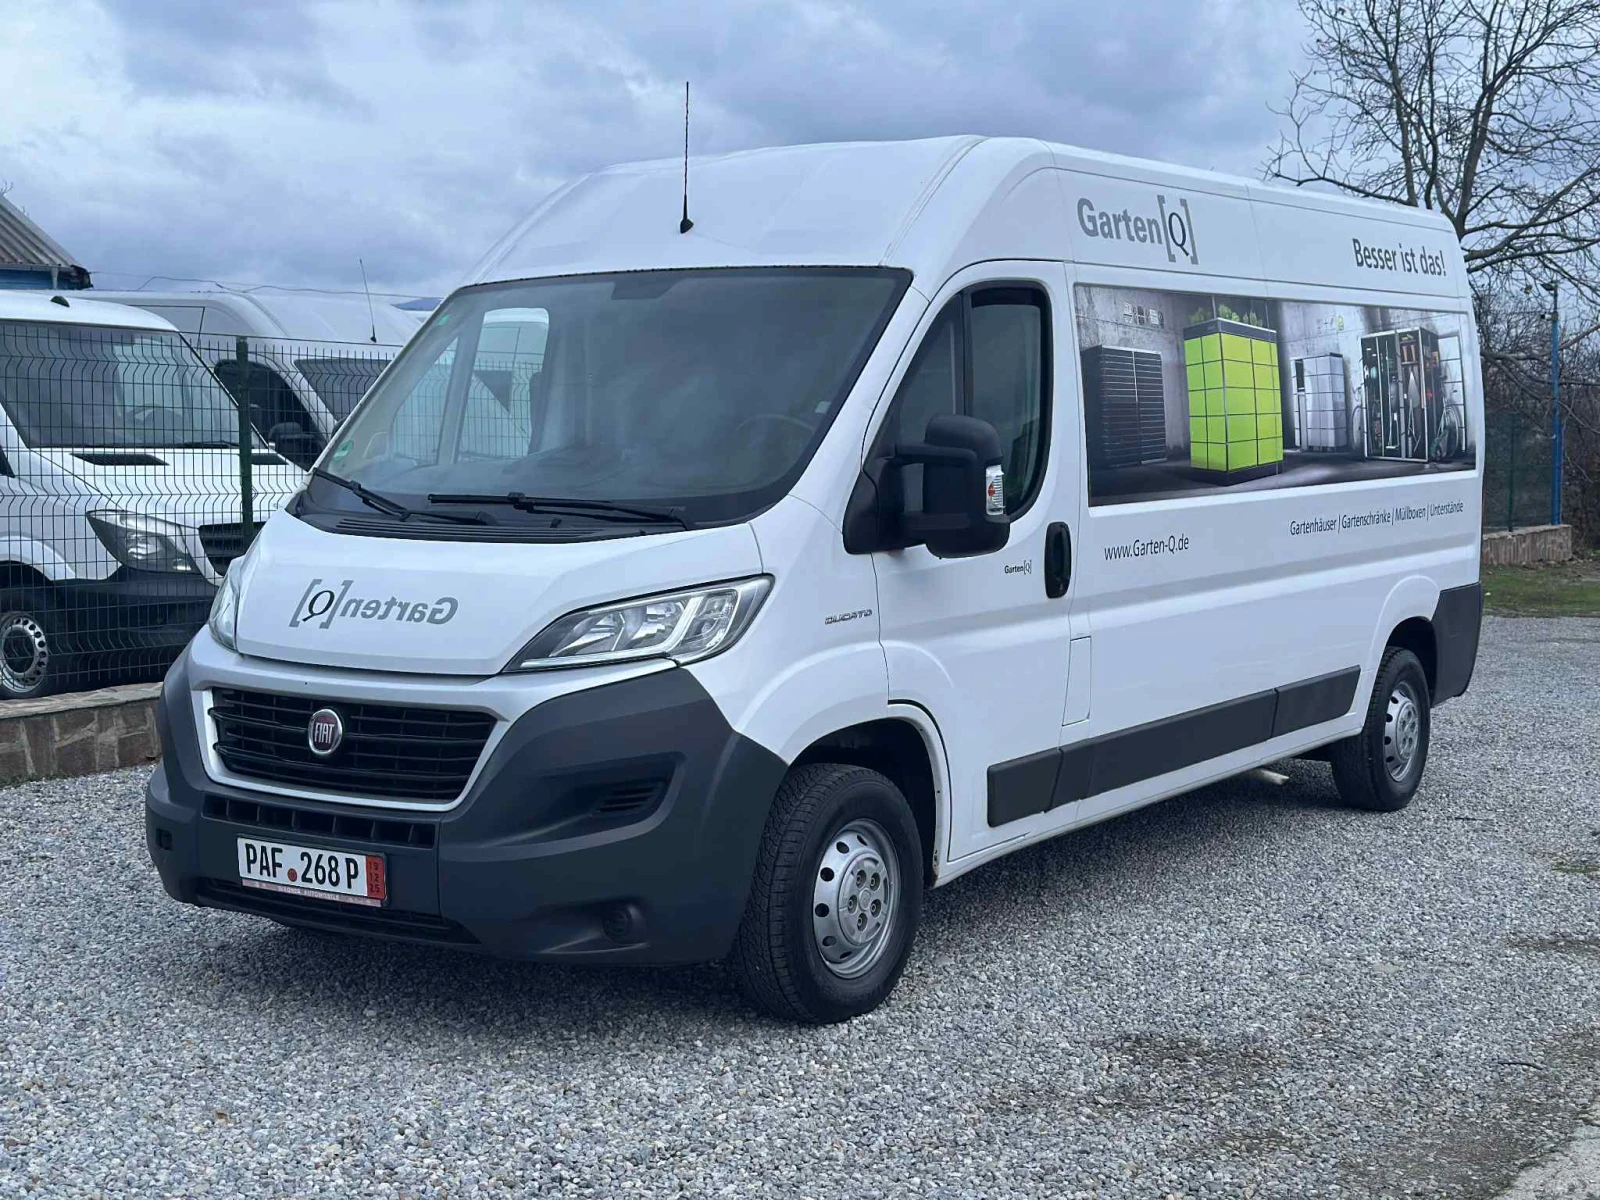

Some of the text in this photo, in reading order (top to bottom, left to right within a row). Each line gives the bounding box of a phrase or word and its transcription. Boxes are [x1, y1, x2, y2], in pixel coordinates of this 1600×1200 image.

[1352, 237, 1447, 277] Besser ist das!
[1290, 516, 1337, 536] Gartenhäuser
[1341, 511, 1391, 529] Gartenschränke
[1395, 505, 1426, 521] Müllboxen
[1429, 499, 1464, 517] Unterstände
[1104, 533, 1189, 561] www.Garten-Q.de
[825, 609, 873, 625] DUCATO
[314, 722, 335, 744] FIAT
[245, 843, 359, 889] PAF 268 P
